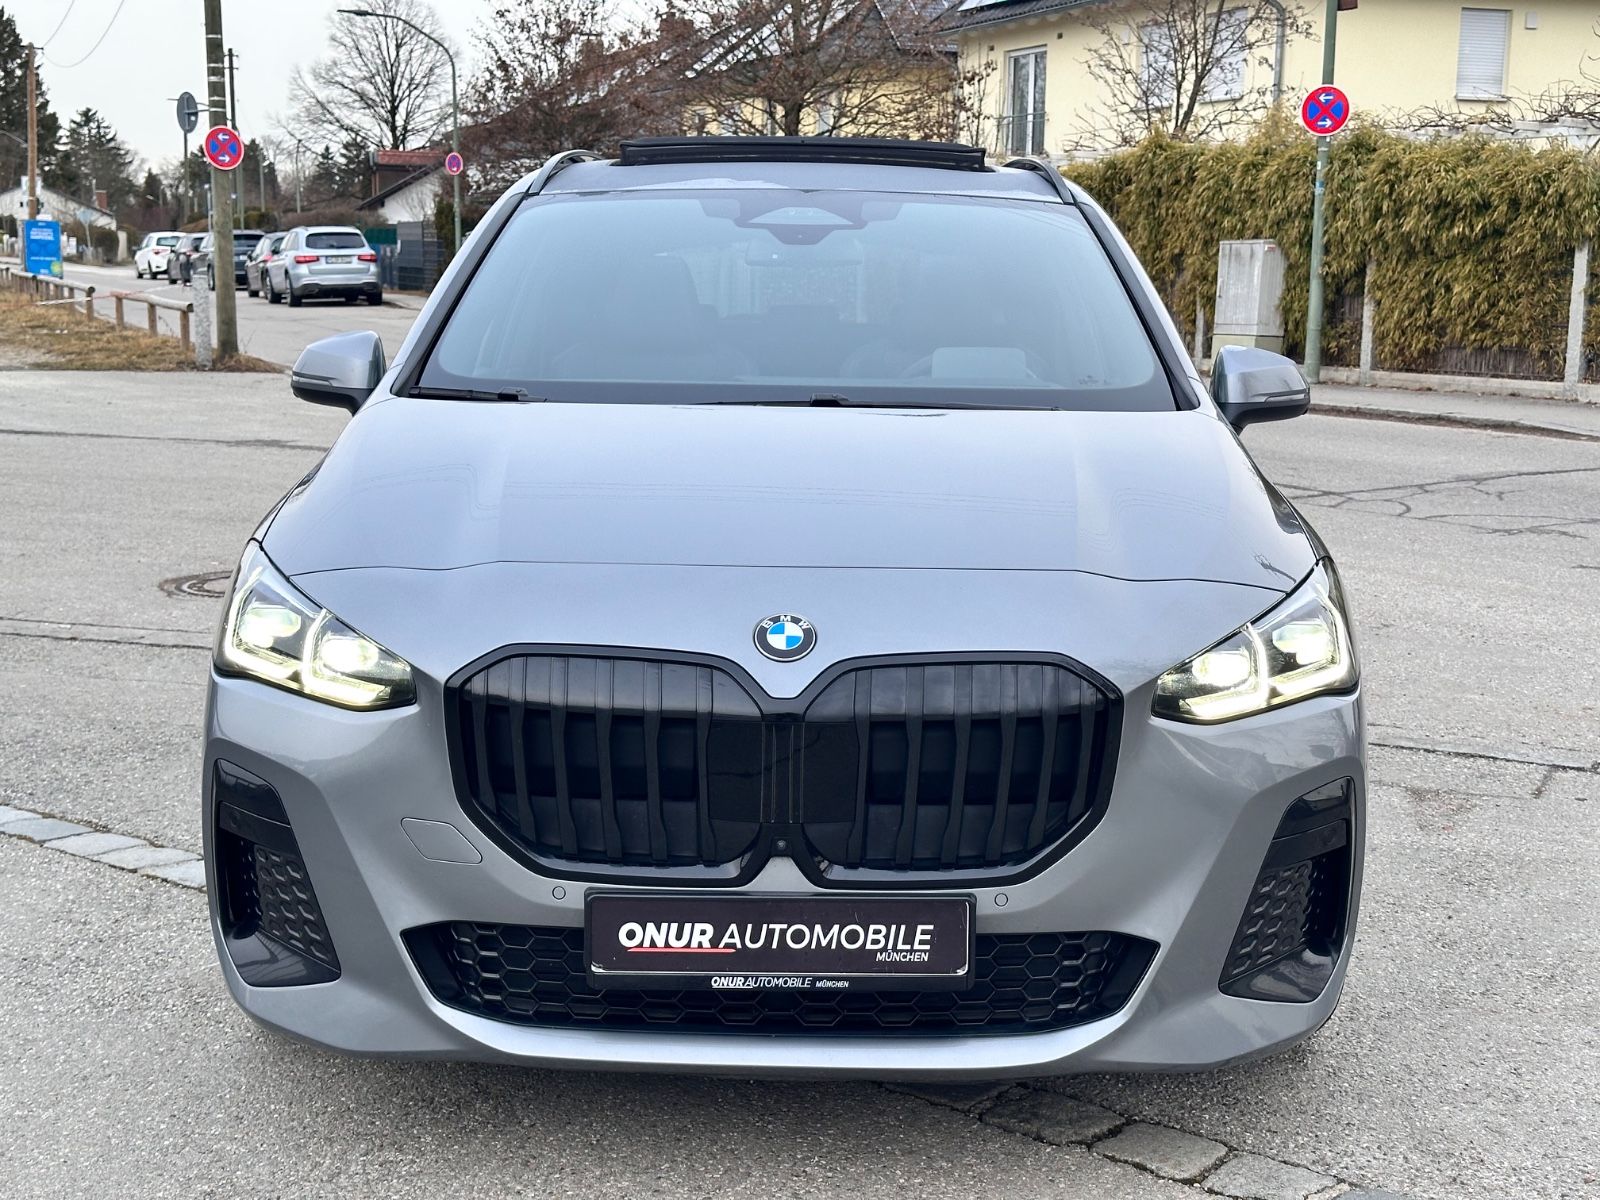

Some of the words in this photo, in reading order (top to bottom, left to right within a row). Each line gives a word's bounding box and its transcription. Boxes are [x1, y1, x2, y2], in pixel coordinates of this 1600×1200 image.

[761, 615, 811, 629] BMW
[618, 922, 715, 950] ONUR
[719, 923, 934, 950] AUTOMOBILE
[875, 950, 929, 962] MÜNCHEN
[711, 976, 745, 988] ONUR
[744, 977, 812, 988] AUTOMOBILE
[815, 979, 849, 988] MÜNCHEN
